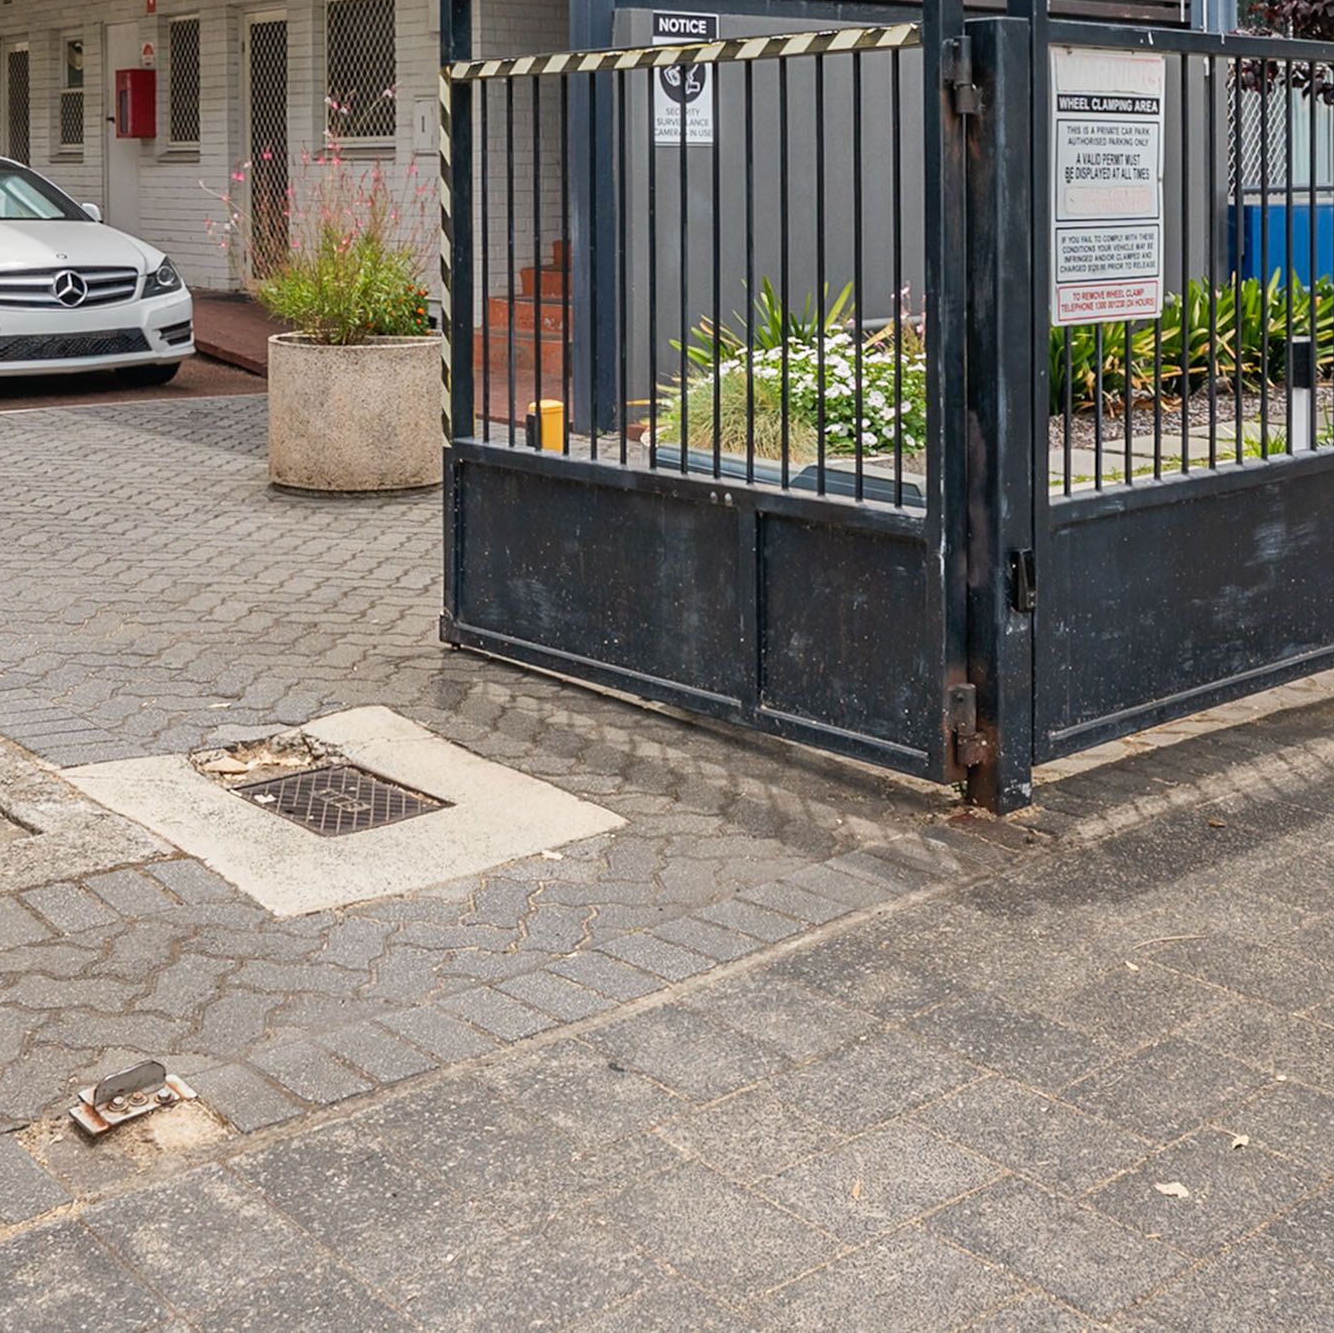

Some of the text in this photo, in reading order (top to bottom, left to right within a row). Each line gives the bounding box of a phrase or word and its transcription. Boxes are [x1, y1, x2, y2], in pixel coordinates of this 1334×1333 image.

[658, 17, 707, 34] NOTICE
[1059, 97, 1158, 113] WHEEL CLAMPING AREA
[1067, 126, 1081, 135] THIS
[1083, 127, 1089, 135] IS
[1097, 127, 1119, 136] PRIVATE
[1121, 127, 1132, 136] CAR
[1134, 128, 1150, 136] PARK
[1068, 137, 1149, 146] AUTHORISED PARKING ONLY
[1076, 153, 1141, 166] A VALID PERMIT MUST
[1065, 166, 1149, 180] BE DISPLAYED AT ALL TIMES
